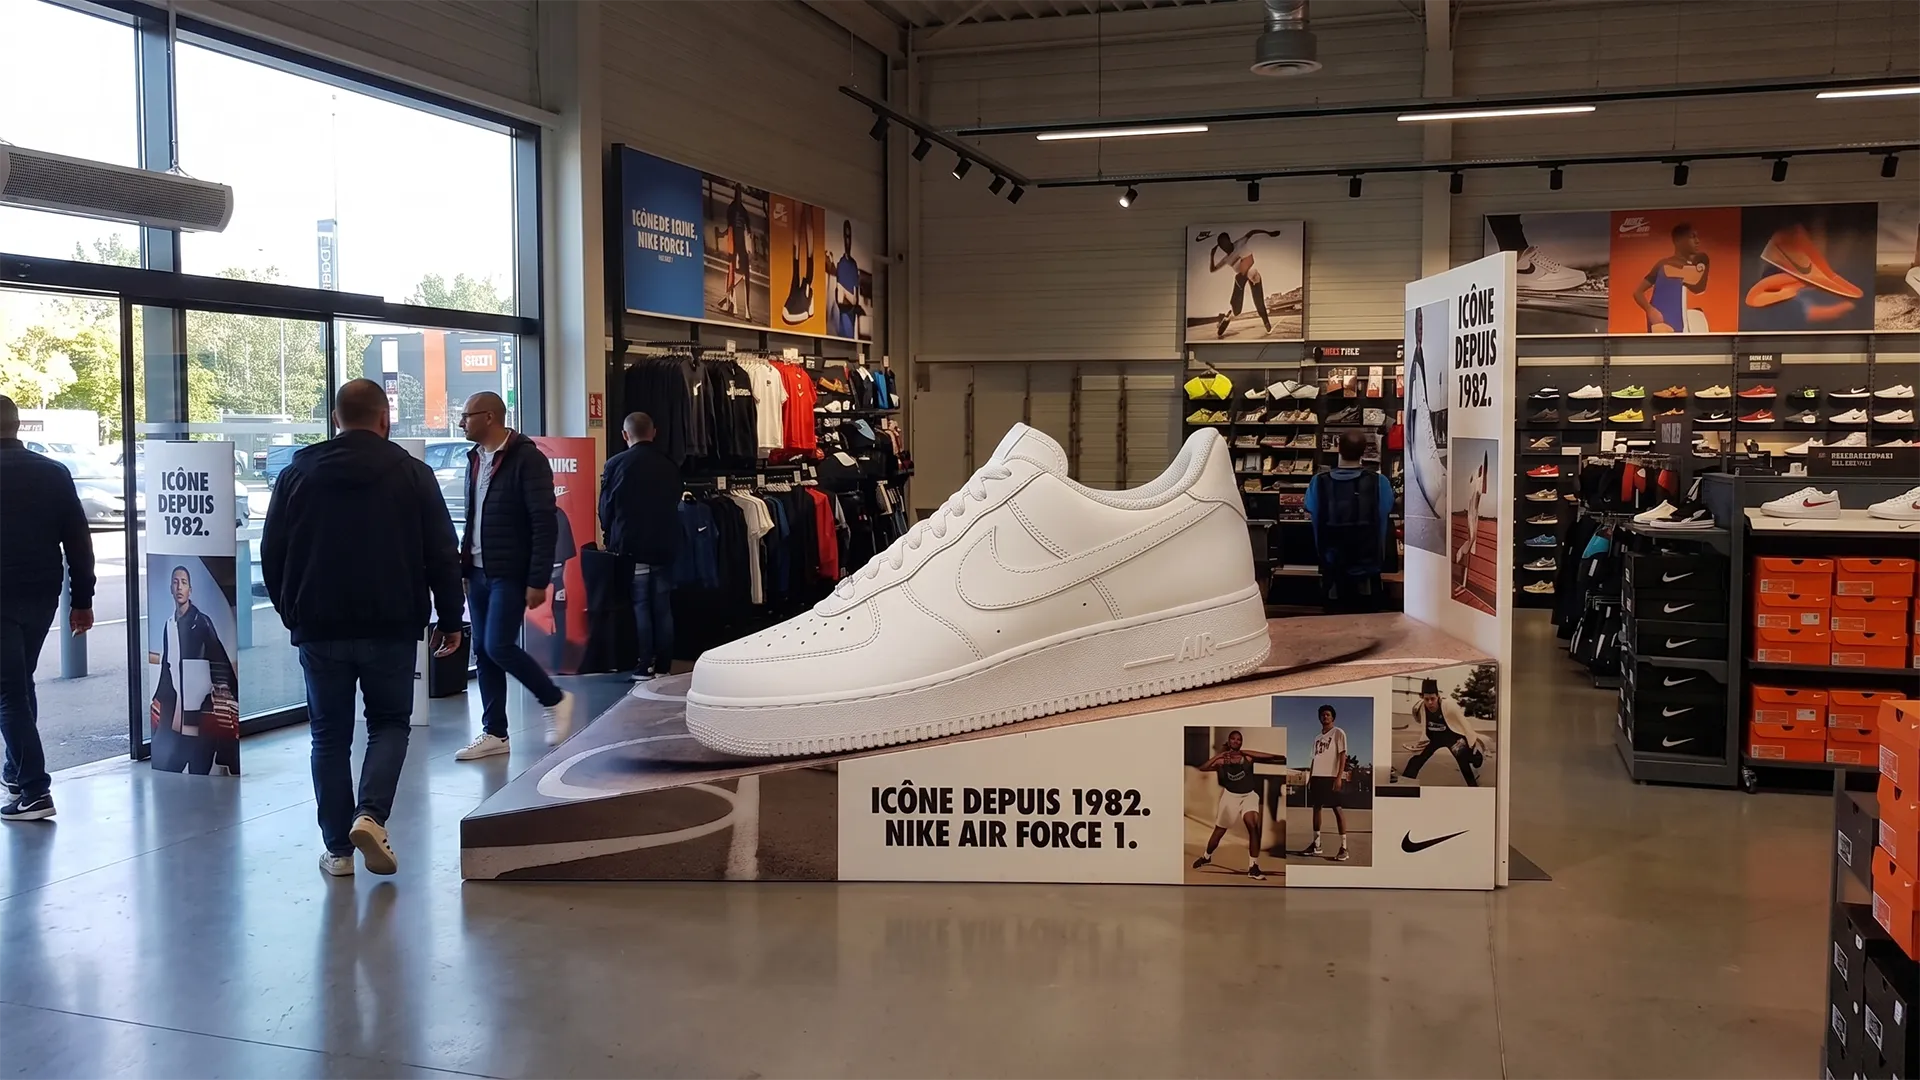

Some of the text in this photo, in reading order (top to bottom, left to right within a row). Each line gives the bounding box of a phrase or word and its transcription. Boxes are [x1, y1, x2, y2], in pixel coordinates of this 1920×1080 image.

[638, 231, 659, 251] NIKE
[660, 236, 685, 256] FORCE
[1458, 283, 1495, 330] ICÔNE
[1455, 329, 1497, 370] DEPUIS
[1459, 372, 1492, 408] 1982.
[161, 466, 209, 492] ICÔNE
[158, 494, 214, 514] DEPUIS
[164, 516, 210, 537] 1982.
[1178, 632, 1215, 664] AIR
[871, 779, 1151, 817] ICÔNE DEPUIS 1982.
[885, 819, 1138, 850] NIKE AIR FORCE 1.
